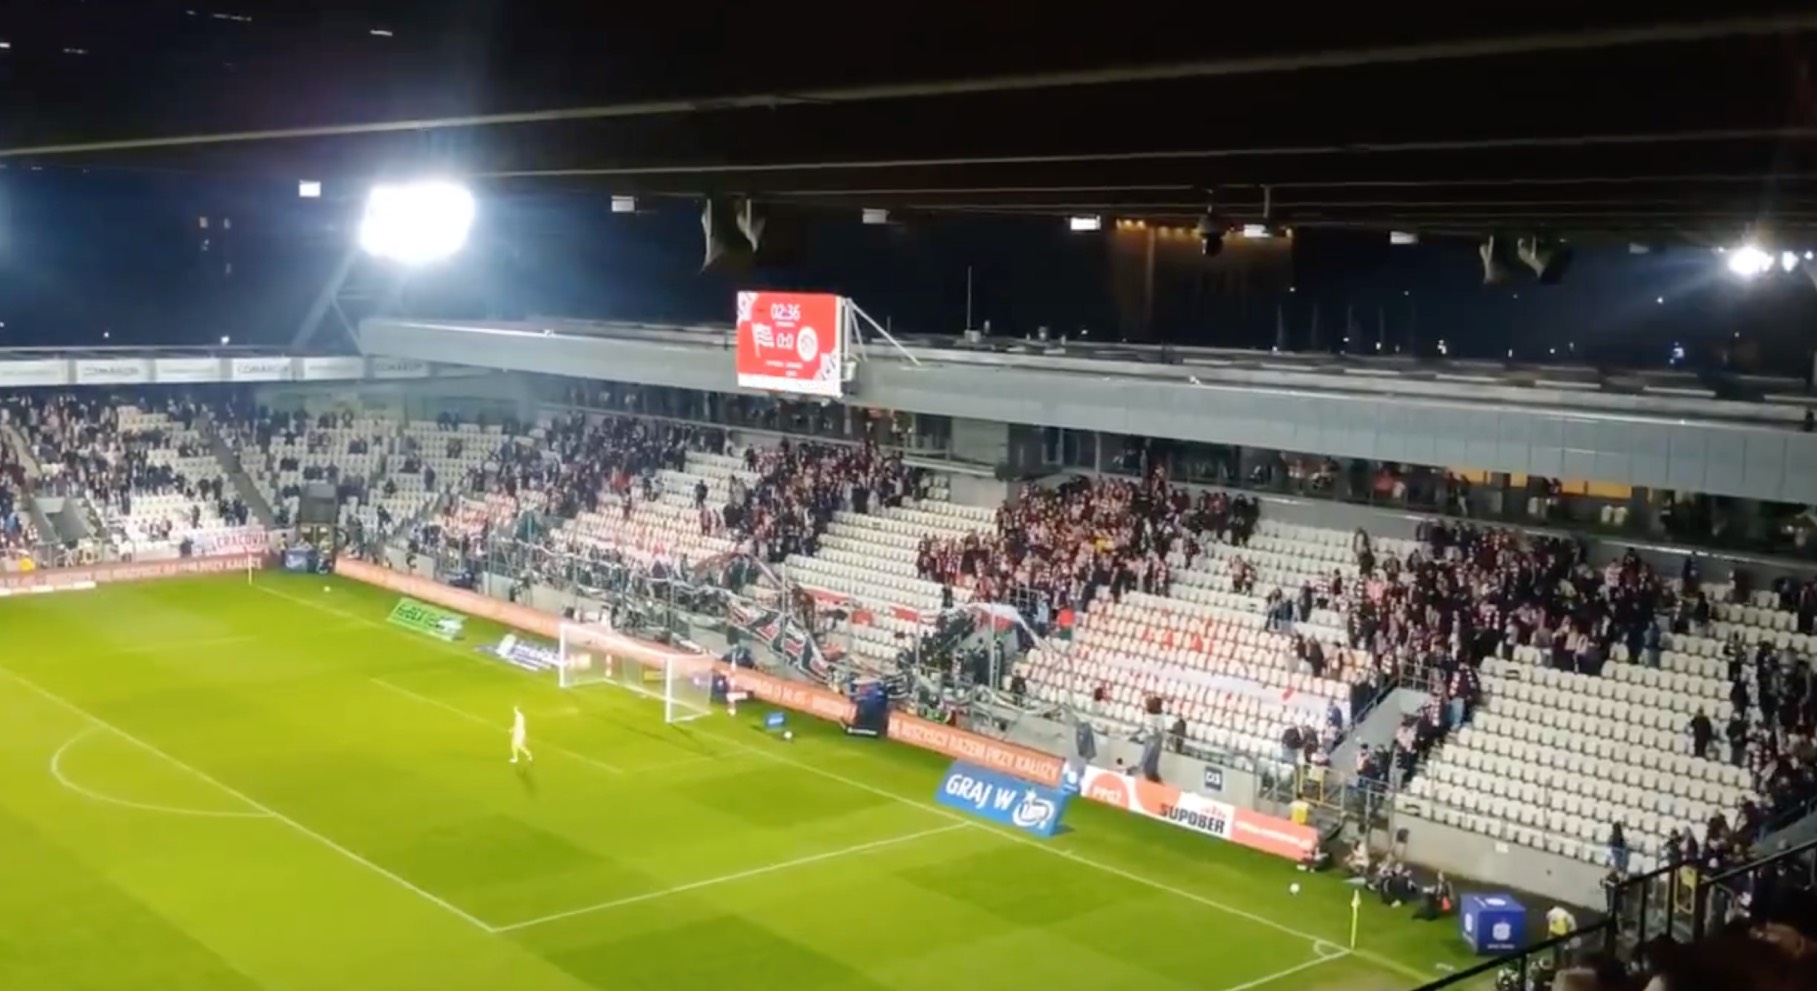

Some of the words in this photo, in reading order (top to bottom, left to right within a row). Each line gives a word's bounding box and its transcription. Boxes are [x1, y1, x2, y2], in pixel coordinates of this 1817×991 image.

[771, 303, 801, 321] 02:36
[945, 774, 993, 809] GRAJ
[994, 787, 1016, 811] W
[1159, 804, 1226, 834] SUPOBER
